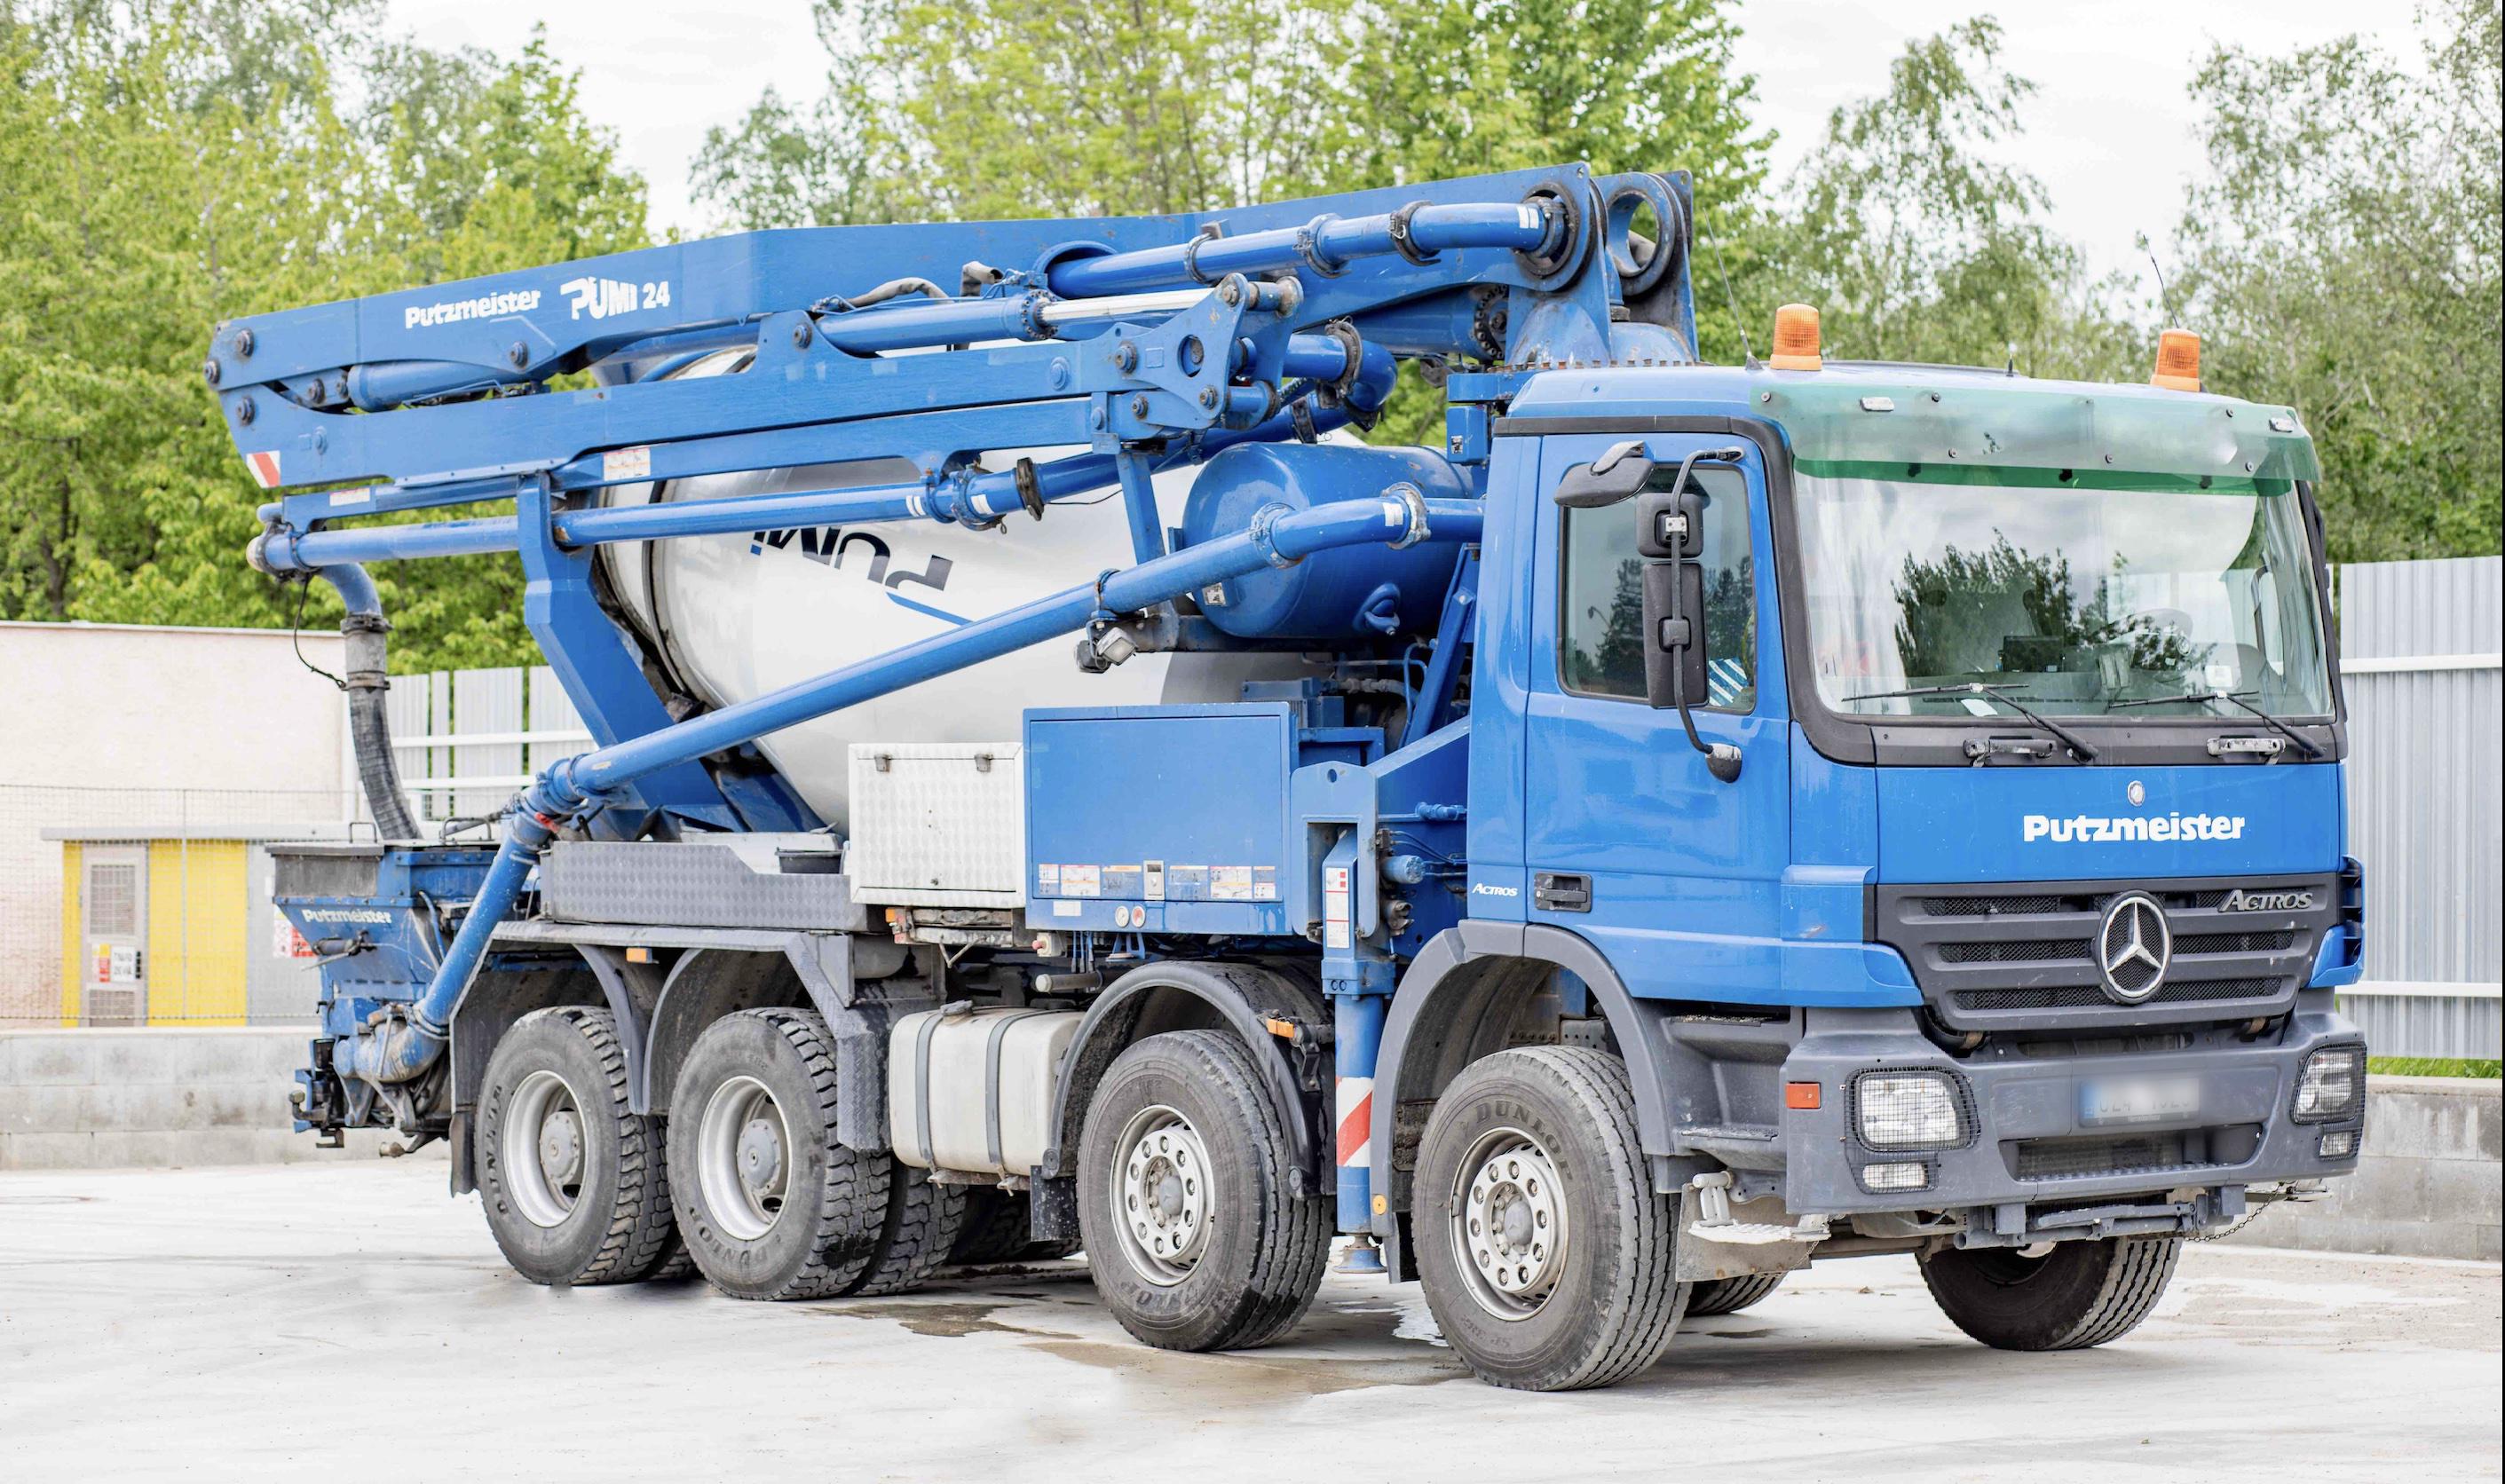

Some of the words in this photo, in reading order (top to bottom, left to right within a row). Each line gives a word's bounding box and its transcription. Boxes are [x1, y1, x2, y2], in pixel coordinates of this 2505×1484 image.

[405, 289, 541, 329] Putzmeister
[560, 276, 638, 321] PUMI
[643, 280, 671, 311] 24
[2022, 811, 2246, 842] Putzmeister
[1472, 882, 1519, 897] ACTROS
[2218, 888, 2314, 913] ACTROS
[301, 908, 392, 924] Putzmeister
[1475, 1100, 1573, 1180] DUNLOP
